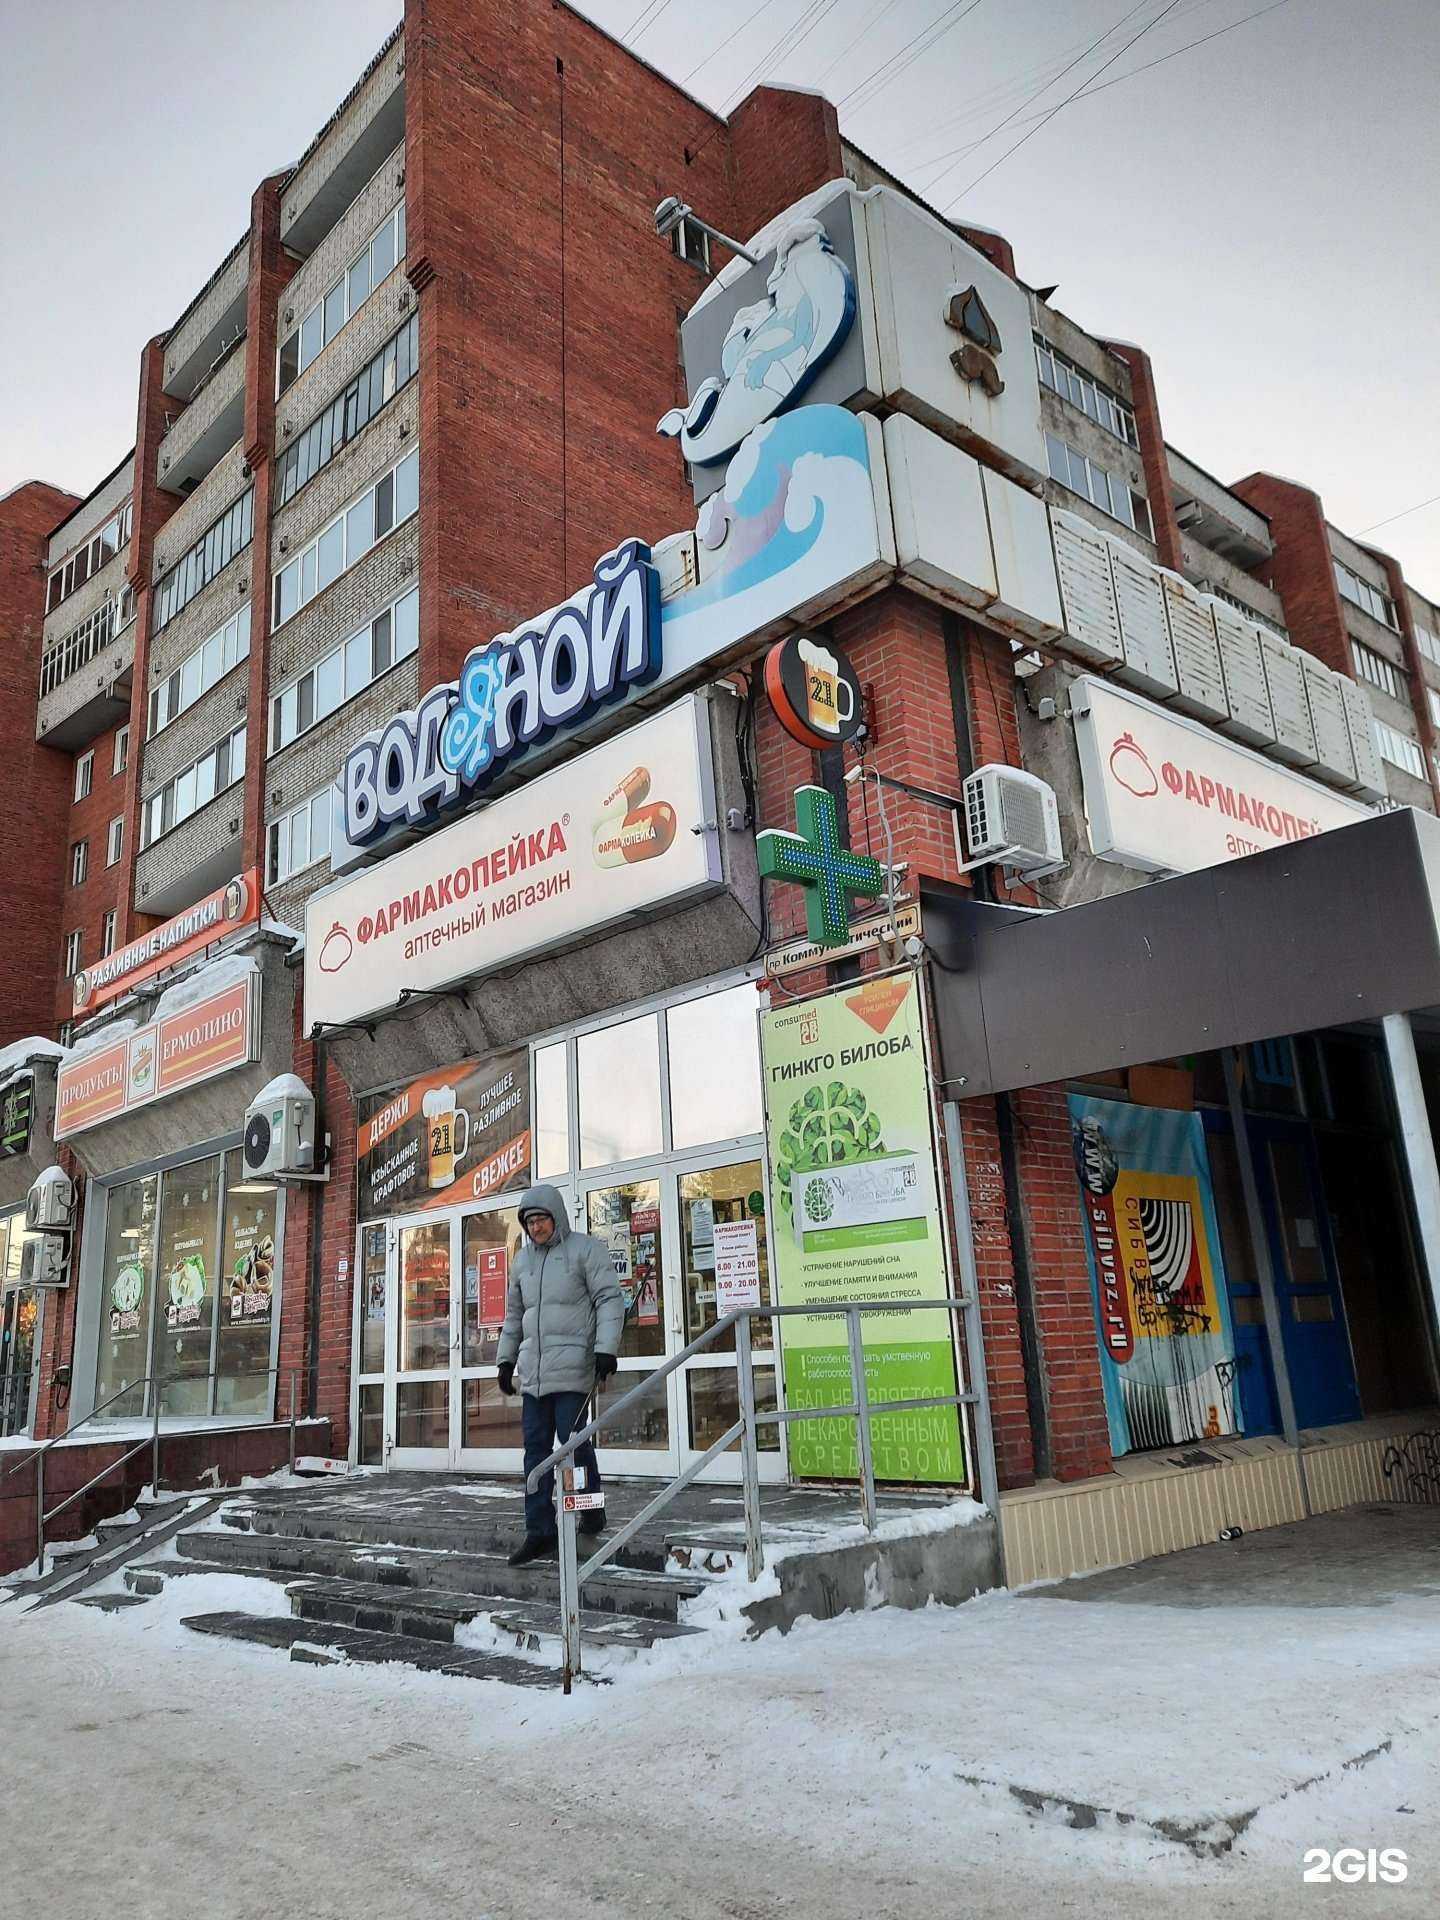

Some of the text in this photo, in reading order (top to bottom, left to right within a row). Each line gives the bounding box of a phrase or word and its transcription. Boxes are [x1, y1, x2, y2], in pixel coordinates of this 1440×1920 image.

[346, 542, 655, 842] ВОДЯНОЙ
[810, 676, 834, 708] 21
[404, 870, 570, 960] аптечный магазин
[91, 900, 217, 989] РАЗЛИВНЫЕ НАПИТКИ
[769, 959, 781, 969] пр
[163, 1007, 243, 1060] ЕРМОЛИНО
[774, 1008, 817, 1028] consumed
[772, 1033, 913, 1082] ГИНКГО БИЛОБА
[61, 1063, 123, 1106] ПРОДУКТЫ
[480, 1072, 513, 1110] ЛУЧШЕЕ
[369, 1093, 409, 1146] ДЕРЖИ
[473, 1088, 522, 1137] РАЗЛИВНОЕ
[431, 1124, 451, 1157] 21
[370, 1138, 419, 1187] ИЗЫСКАННОЕ
[373, 1161, 416, 1205] КРАФТОВОЕ
[473, 1140, 525, 1196] СВЕЖЕЕ
[803, 1255, 901, 1272] УСТРАНЕНИЕ НАРУШЕНИЙ СНА
[804, 1271, 918, 1289] УЛУЧШЕНИЕ ПАМЯТИ И ВНИМАНИЯ
[805, 1288, 922, 1305] УМЕНЬШЕНИЕ СОСТОЯНИЯ СТРЕССА
[806, 1312, 847, 1322] УСТРАНЕНИЕ
[881, 1352, 932, 1366] умственную
